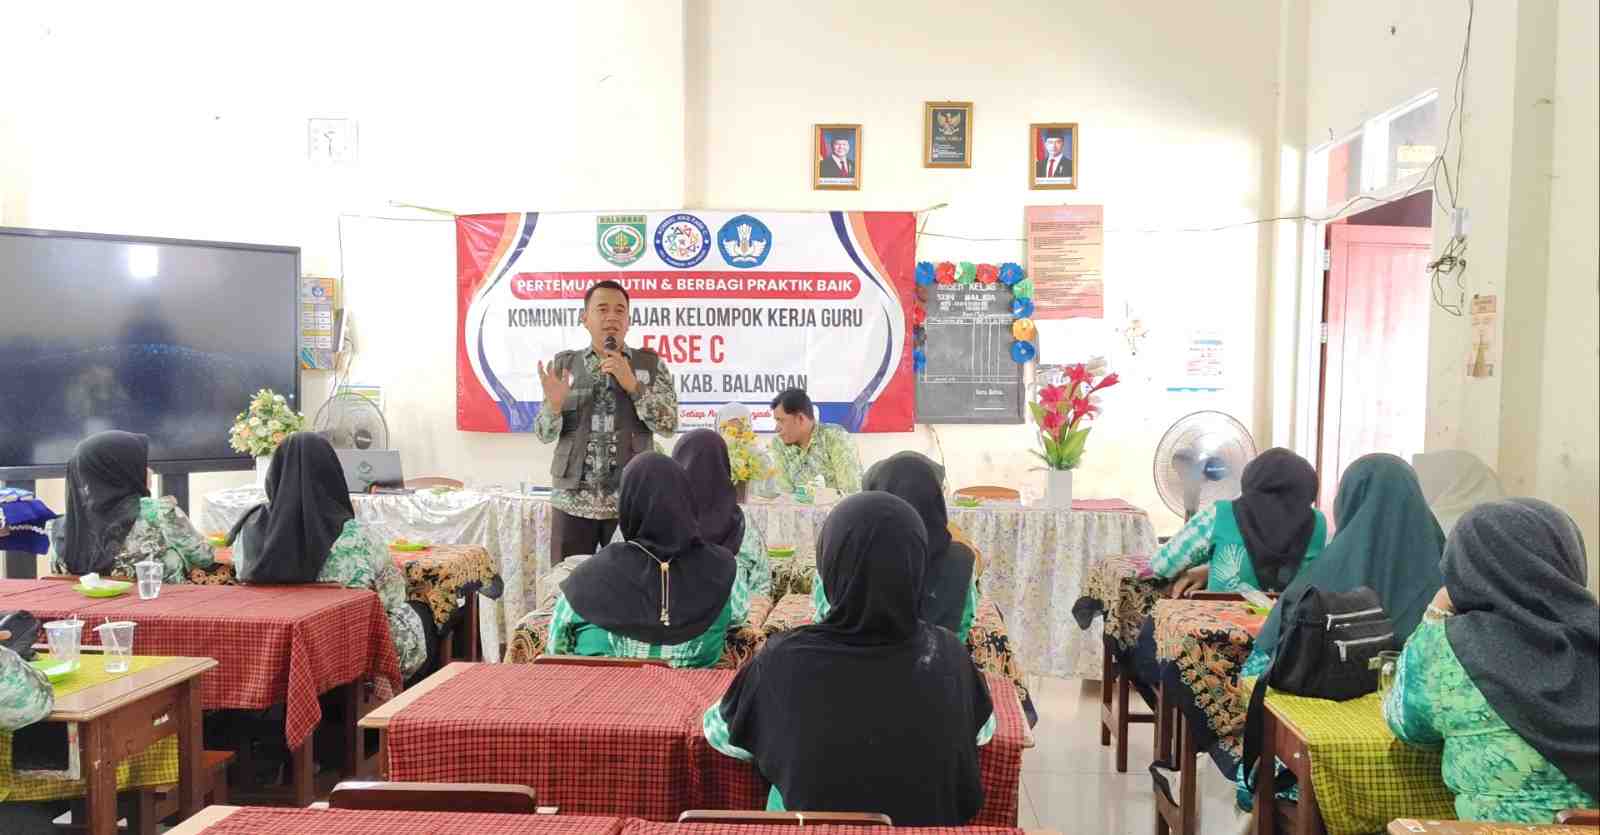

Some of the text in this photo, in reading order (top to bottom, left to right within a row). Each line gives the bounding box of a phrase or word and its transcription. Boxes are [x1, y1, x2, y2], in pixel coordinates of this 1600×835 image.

[517, 279, 603, 292] PERTEMUA
[661, 279, 672, 290] &
[677, 279, 743, 291] BERBAGI
[748, 279, 813, 291] PRAKTIK
[816, 279, 853, 291] BAIK
[508, 307, 863, 328] KOMUNITA AJAR KELOMPOK KERJA GURU
[710, 335, 725, 363] C
[681, 374, 717, 393] KAB.
[722, 374, 808, 393] BALANGAN
